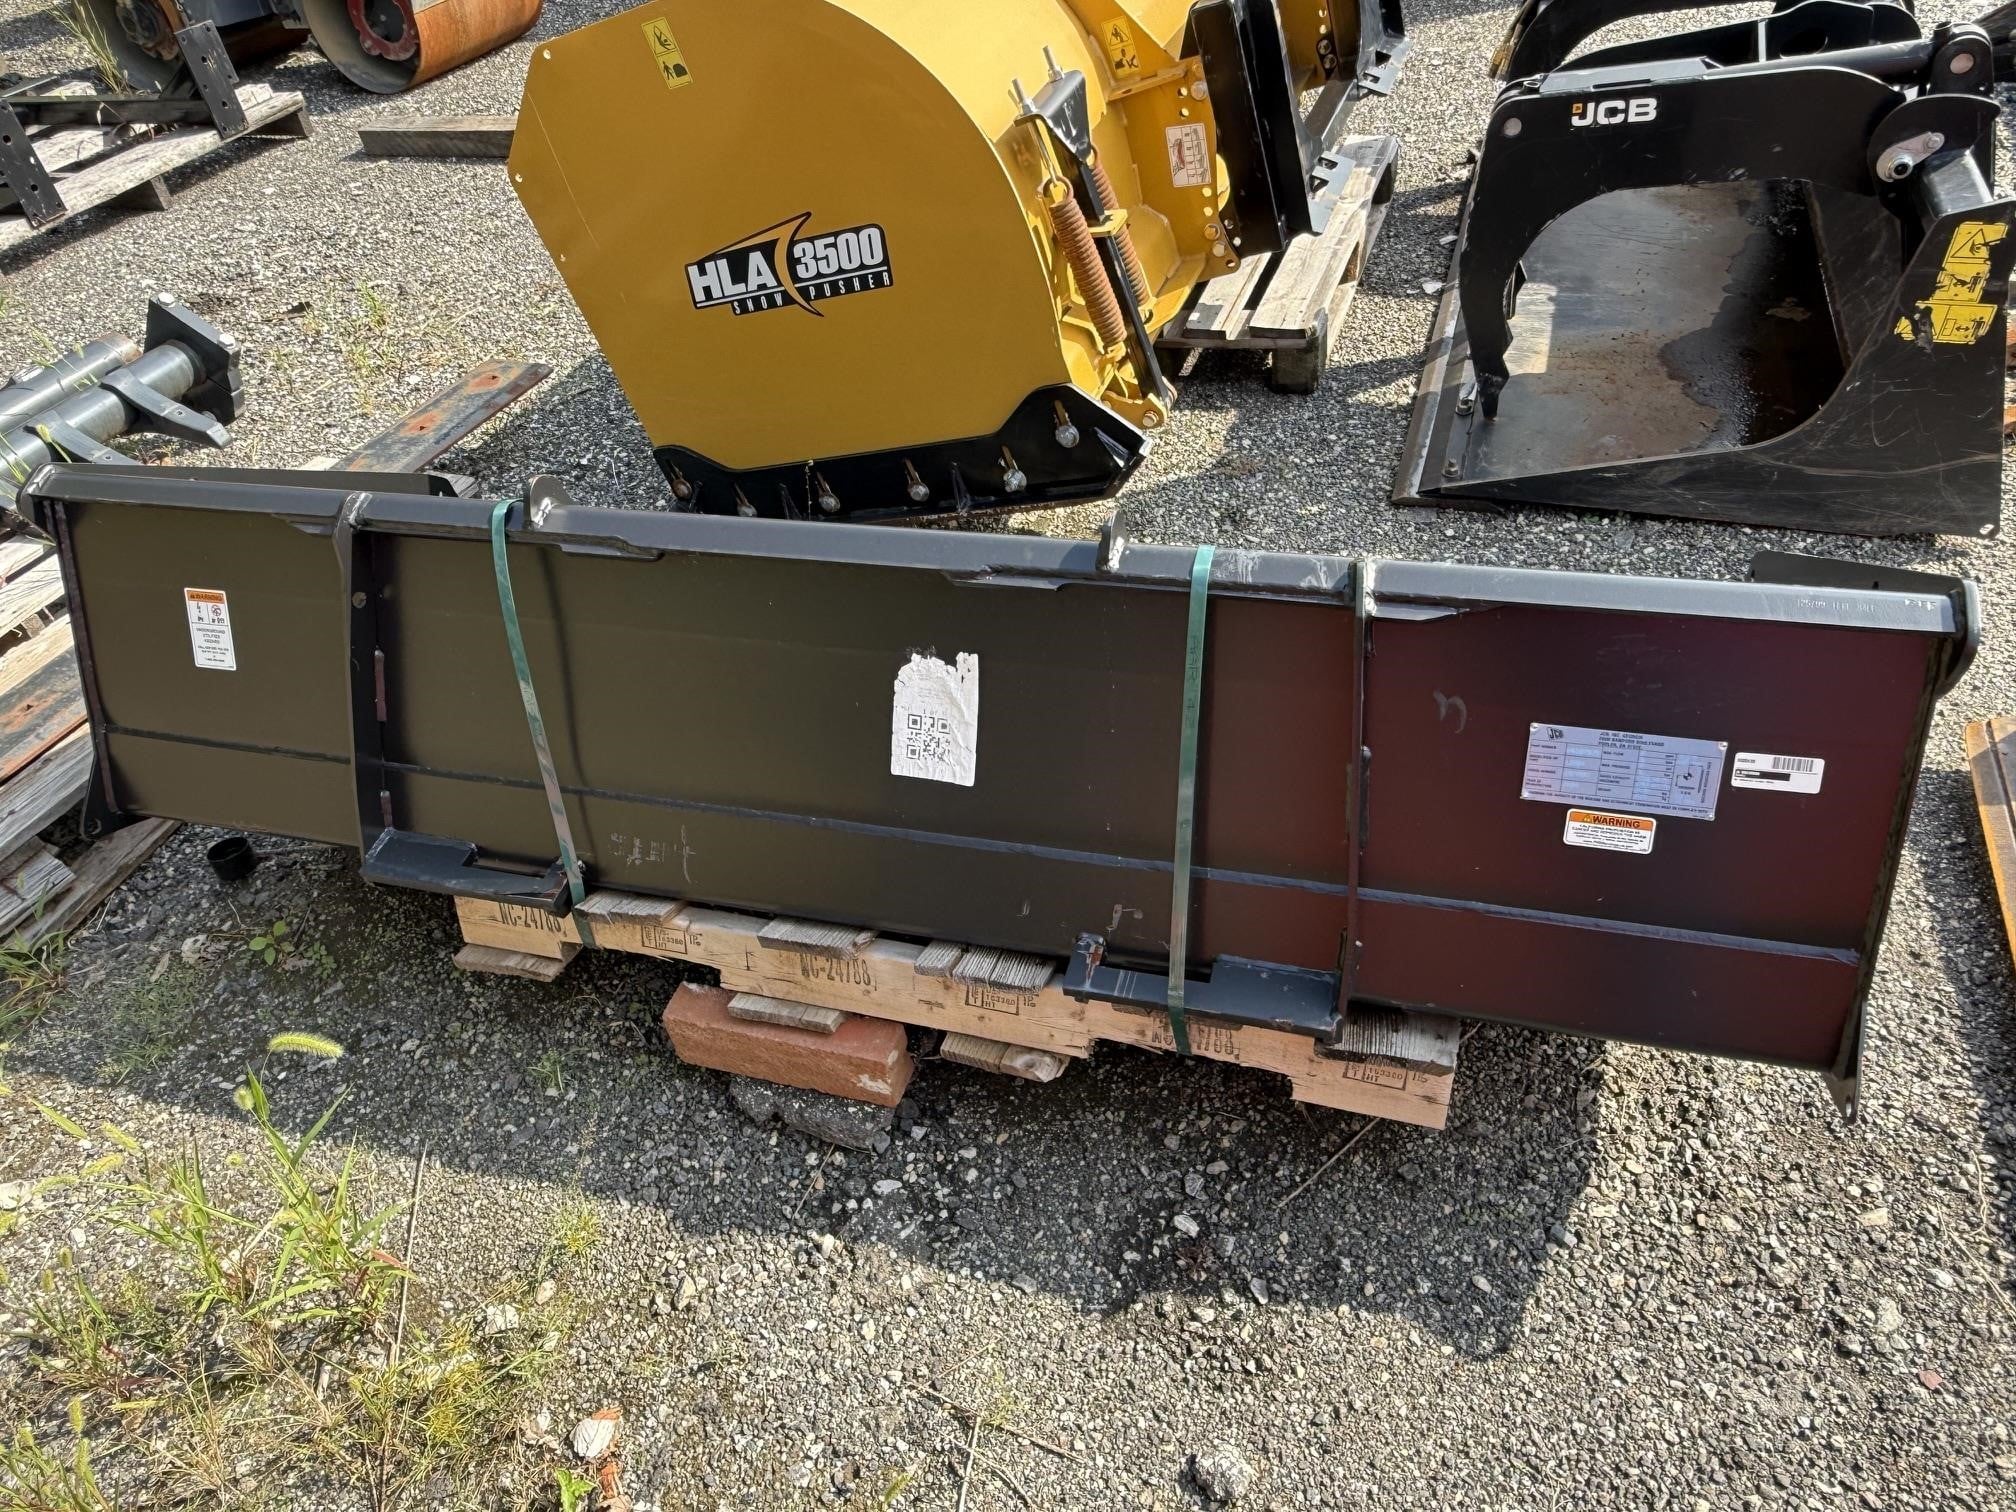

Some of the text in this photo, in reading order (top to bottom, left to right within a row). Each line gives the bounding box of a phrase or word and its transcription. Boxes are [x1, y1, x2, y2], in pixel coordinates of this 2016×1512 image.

[1571, 98, 1657, 126] JCB
[687, 227, 884, 302] HLA 3500
[733, 272, 890, 314] SNOW PUSHER
[1592, 815, 1641, 829] WARNING
